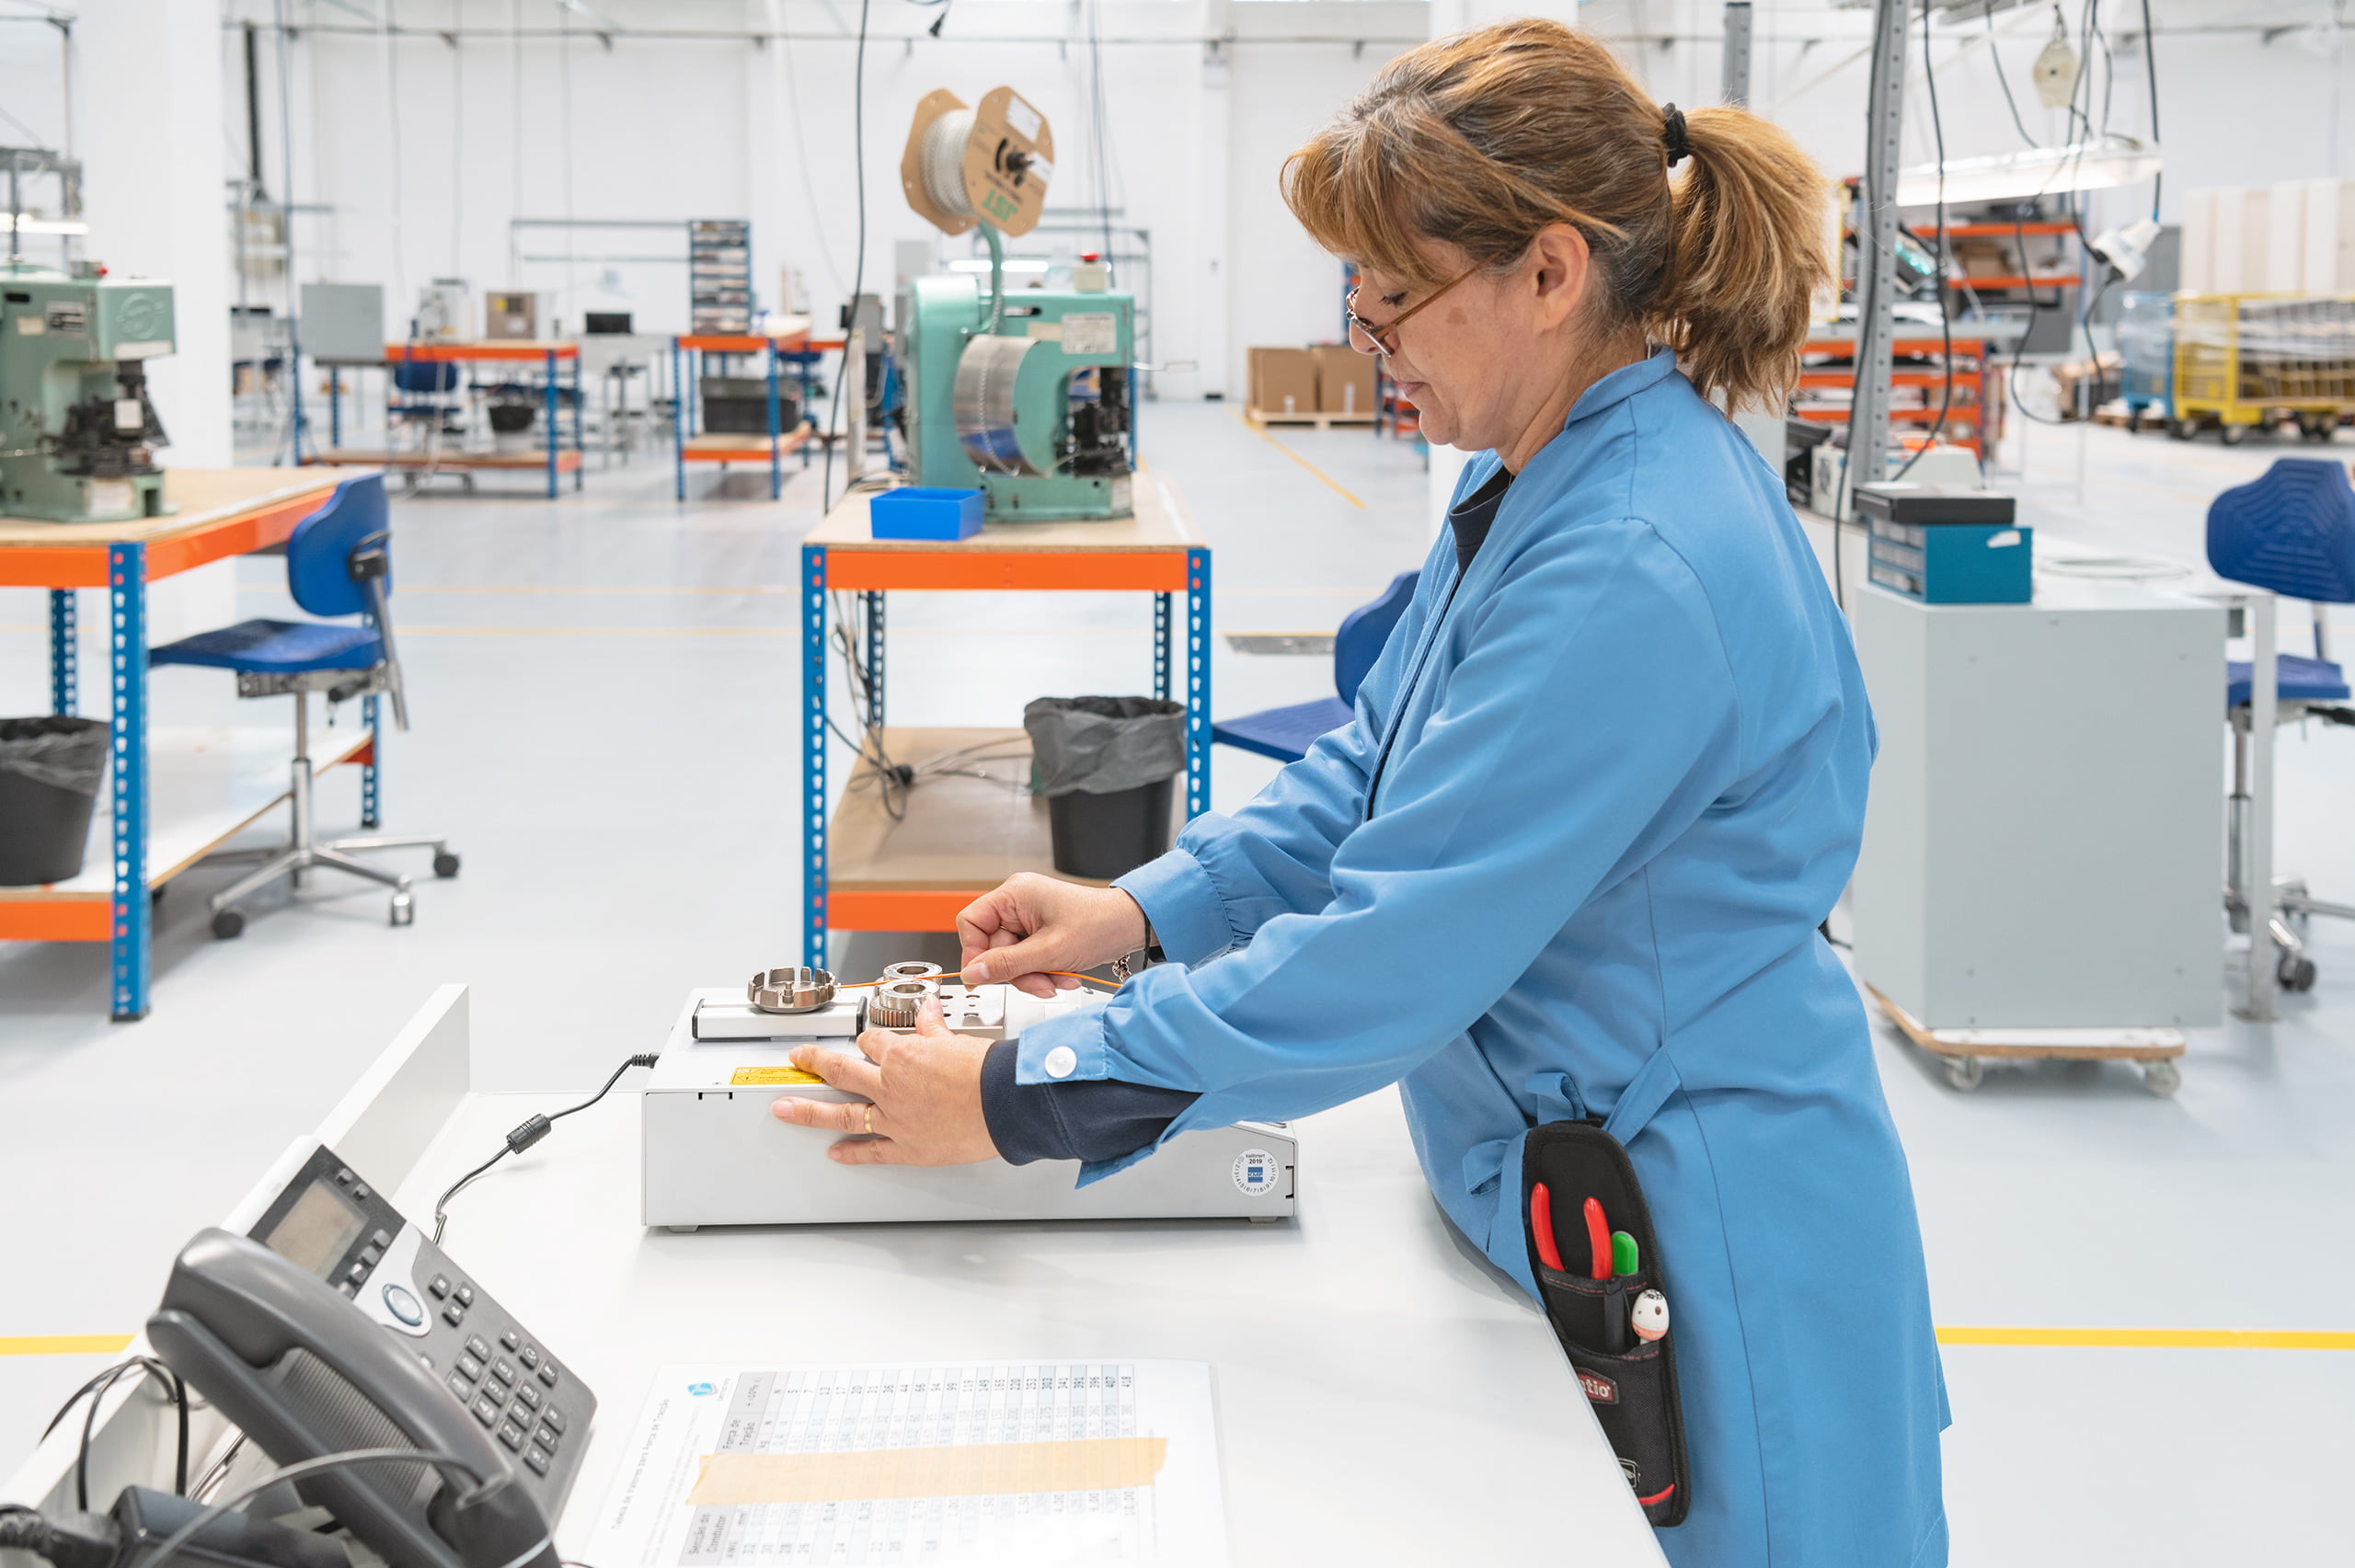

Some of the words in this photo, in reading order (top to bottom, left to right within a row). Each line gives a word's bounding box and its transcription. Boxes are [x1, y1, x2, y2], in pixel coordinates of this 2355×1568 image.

[915, 1383, 926, 1391] 66
[931, 1383, 941, 1391] 94
[947, 1382, 957, 1390] 99
[963, 1380, 973, 1392] 119
[979, 1379, 989, 1391] 149
[995, 1379, 1005, 1391] 165
[1011, 1378, 1020, 1390] 220
[1026, 1378, 1036, 1390] 253
[1042, 1378, 1052, 1389] 303
[1058, 1377, 1067, 1389] 341
[1074, 1377, 1083, 1388] 391
[1089, 1376, 1098, 1388] 396
[1105, 1376, 1114, 1387] 407
[1121, 1376, 1130, 1387] 418
[819, 1386, 830, 1394] 13
[835, 1385, 846, 1394] 17
[851, 1385, 862, 1393] 20
[867, 1384, 878, 1393] 31
[883, 1384, 894, 1392] 36
[899, 1384, 910, 1392] 44
[728, 1419, 741, 1428] de
[740, 1422, 755, 1444] Tração
[722, 1431, 738, 1448] Força
